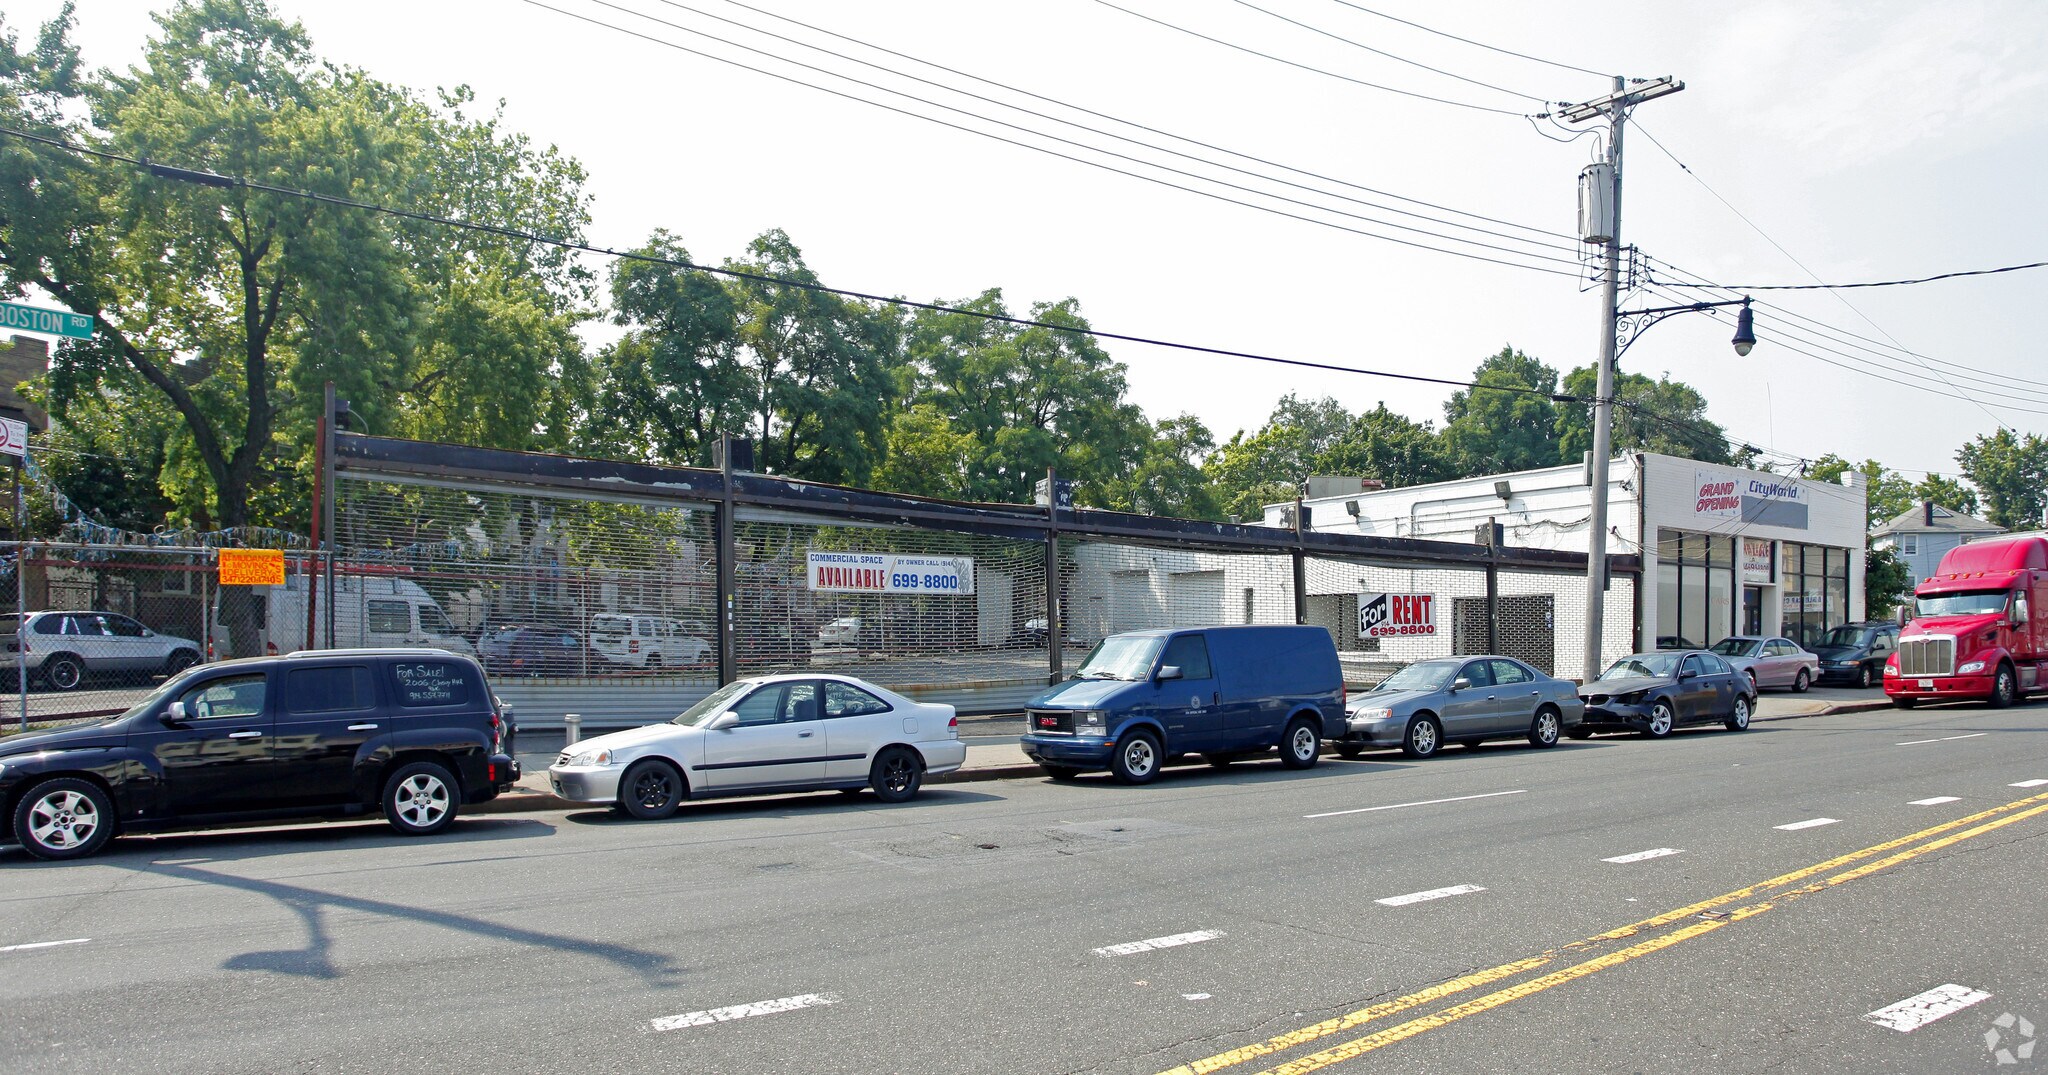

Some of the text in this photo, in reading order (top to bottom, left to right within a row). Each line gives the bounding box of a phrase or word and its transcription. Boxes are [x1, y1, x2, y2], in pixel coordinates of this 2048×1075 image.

[0, 305, 87, 332] BOSTON RD
[1699, 482, 1735, 497] GRAND
[1749, 480, 1798, 498] CityWorld
[1696, 496, 1739, 512] OPENING
[810, 553, 883, 564] COMMERCIAL SPACE
[817, 566, 885, 590] AVAILABLE
[892, 573, 958, 589] 699-8800
[1361, 595, 1432, 629] For RENT
